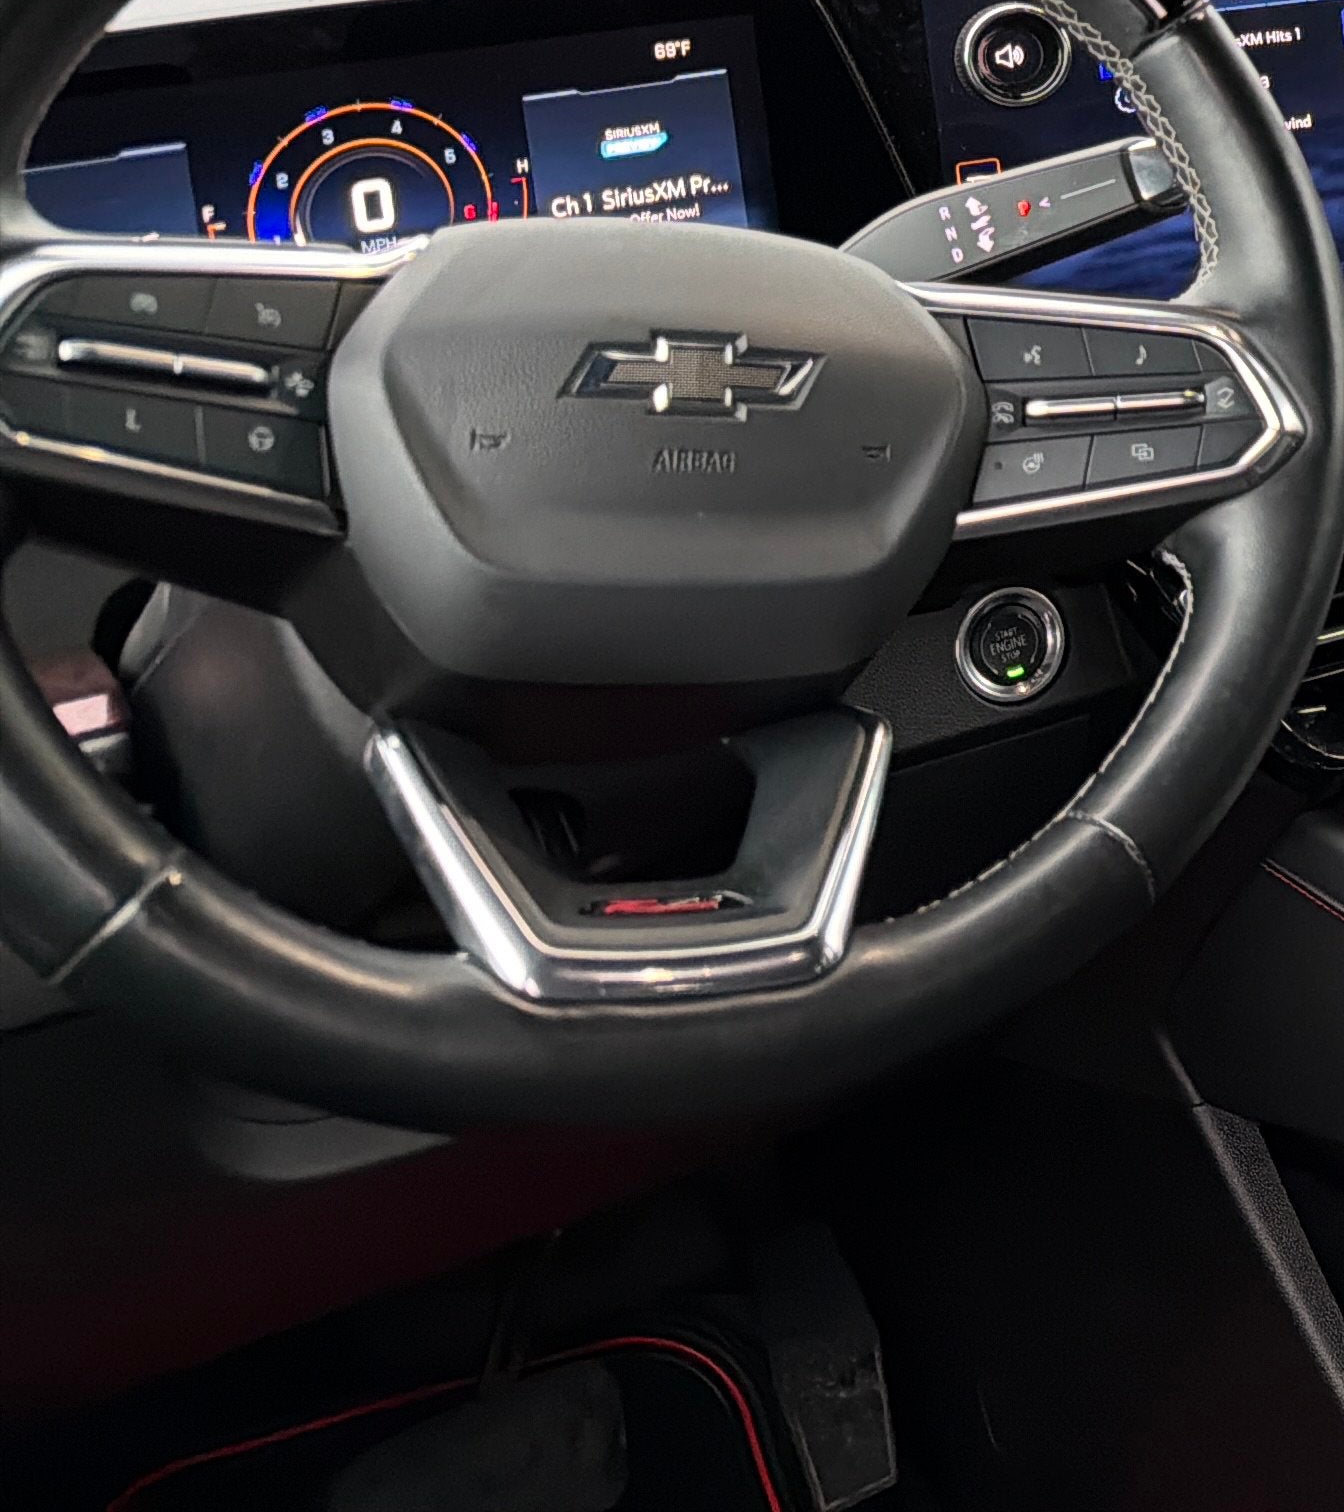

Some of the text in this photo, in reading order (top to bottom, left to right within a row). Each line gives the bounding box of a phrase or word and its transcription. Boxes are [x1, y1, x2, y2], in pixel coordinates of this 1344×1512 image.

[1266, 29, 1292, 44] Hits
[1294, 27, 1301, 41] 1
[391, 119, 402, 135] 4
[605, 121, 660, 140] SIRIUSXM
[321, 129, 334, 145] 3
[516, 157, 529, 174] H
[276, 172, 289, 189] 2
[350, 177, 395, 233] 0
[551, 195, 579, 218] Ch
[584, 192, 593, 213] 1
[602, 177, 686, 211] SiriusXM
[666, 203, 700, 221] Now!
[939, 206, 951, 221] R
[945, 226, 957, 242] N
[951, 248, 964, 264] D
[651, 448, 736, 474] AIRBAG
[995, 627, 1018, 641] START
[990, 634, 1027, 656] ENGINE
[1001, 650, 1021, 663] STOP
